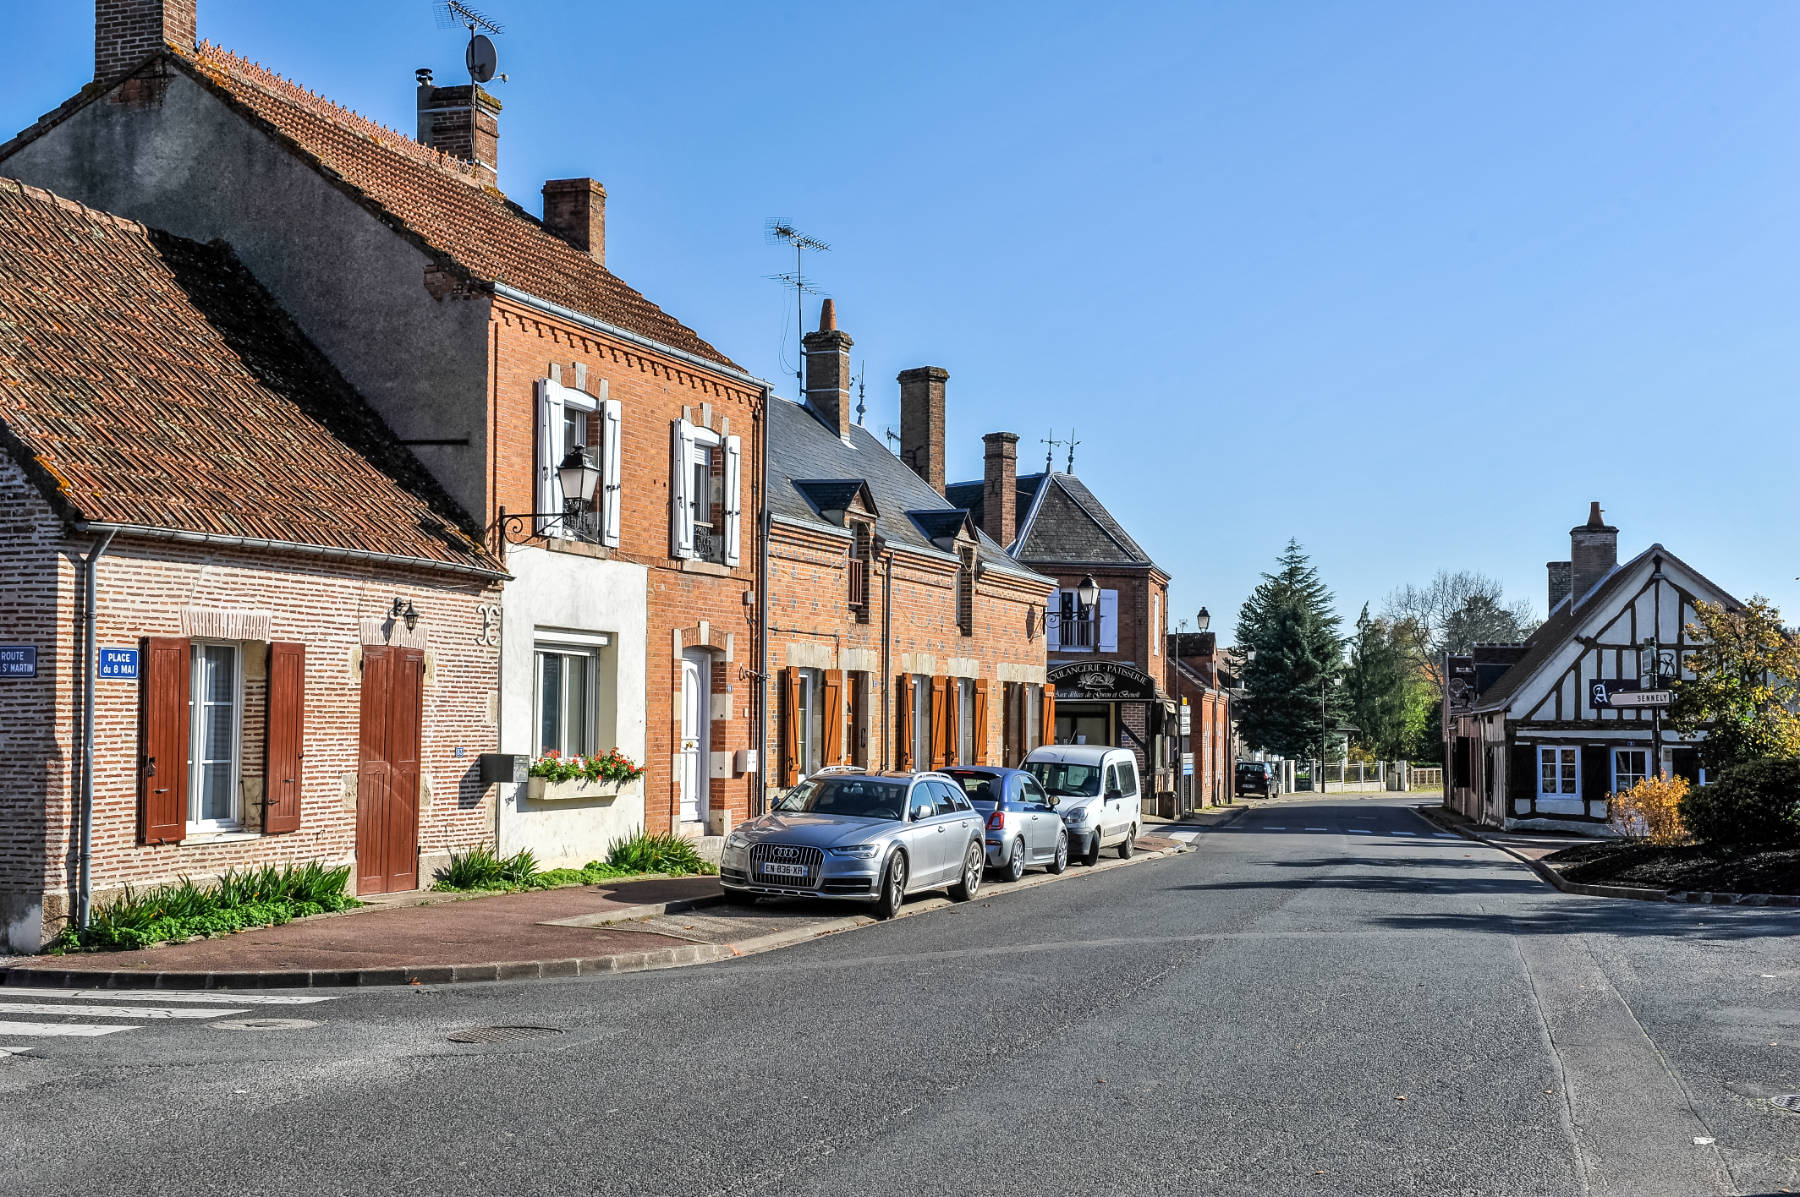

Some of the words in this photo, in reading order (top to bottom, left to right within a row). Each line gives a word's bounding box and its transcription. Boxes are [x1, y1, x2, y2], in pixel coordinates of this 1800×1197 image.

[1, 651, 24, 661] ROUTE
[108, 652, 131, 663] PLACE
[10, 663, 33, 672] MARTIN
[103, 664, 111, 674] du
[113, 664, 119, 674] 8
[121, 664, 135, 674] MAI
[1047, 663, 1101, 681] OULANGERIE
[1636, 694, 1668, 702] SENNELY
